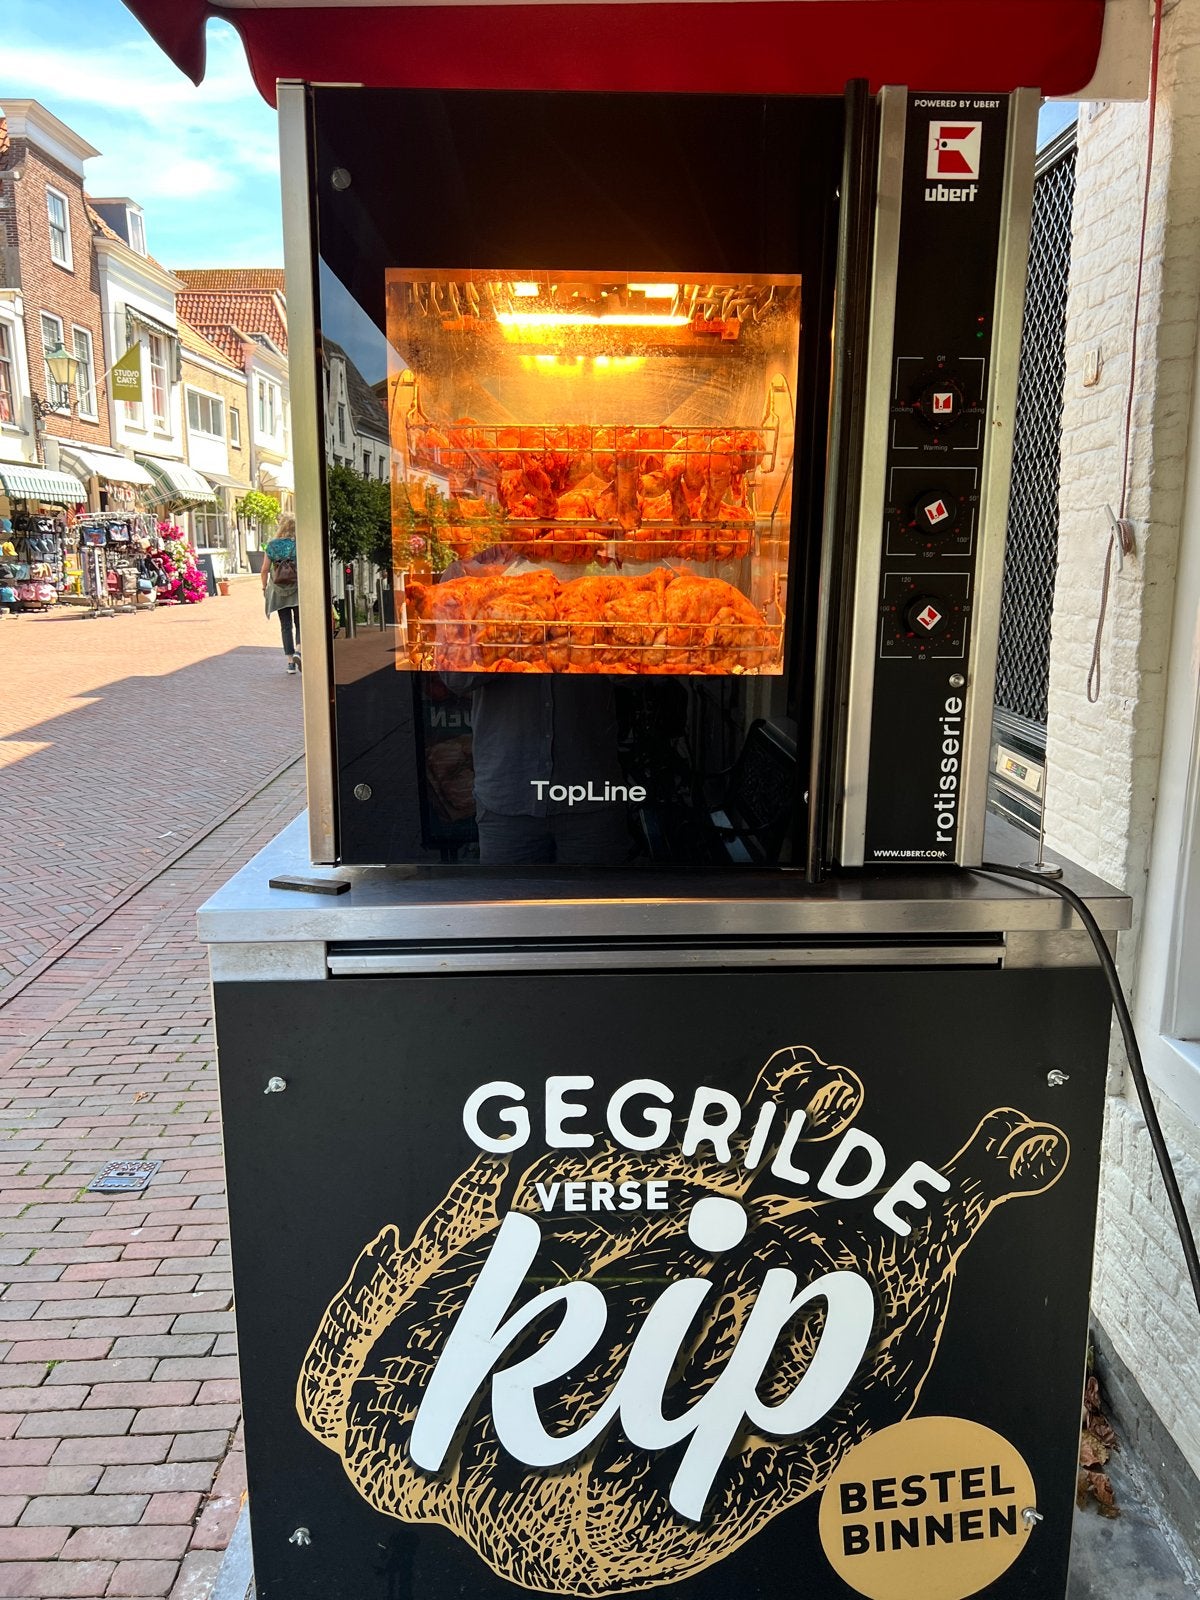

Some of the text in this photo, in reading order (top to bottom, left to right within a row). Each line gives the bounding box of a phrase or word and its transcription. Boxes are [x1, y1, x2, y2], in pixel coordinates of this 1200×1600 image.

[914, 100, 1000, 108] POWERED BY UBERT
[924, 184, 978, 202] ubert
[530, 780, 647, 806] TopLine
[934, 696, 963, 842] rotisserie
[462, 1075, 952, 1237] GEGRILDE
[535, 1180, 670, 1213] VERSE
[409, 1197, 875, 1522] kip
[839, 1465, 1016, 1516] BESTEL
[841, 1505, 1017, 1556] BINNEN
